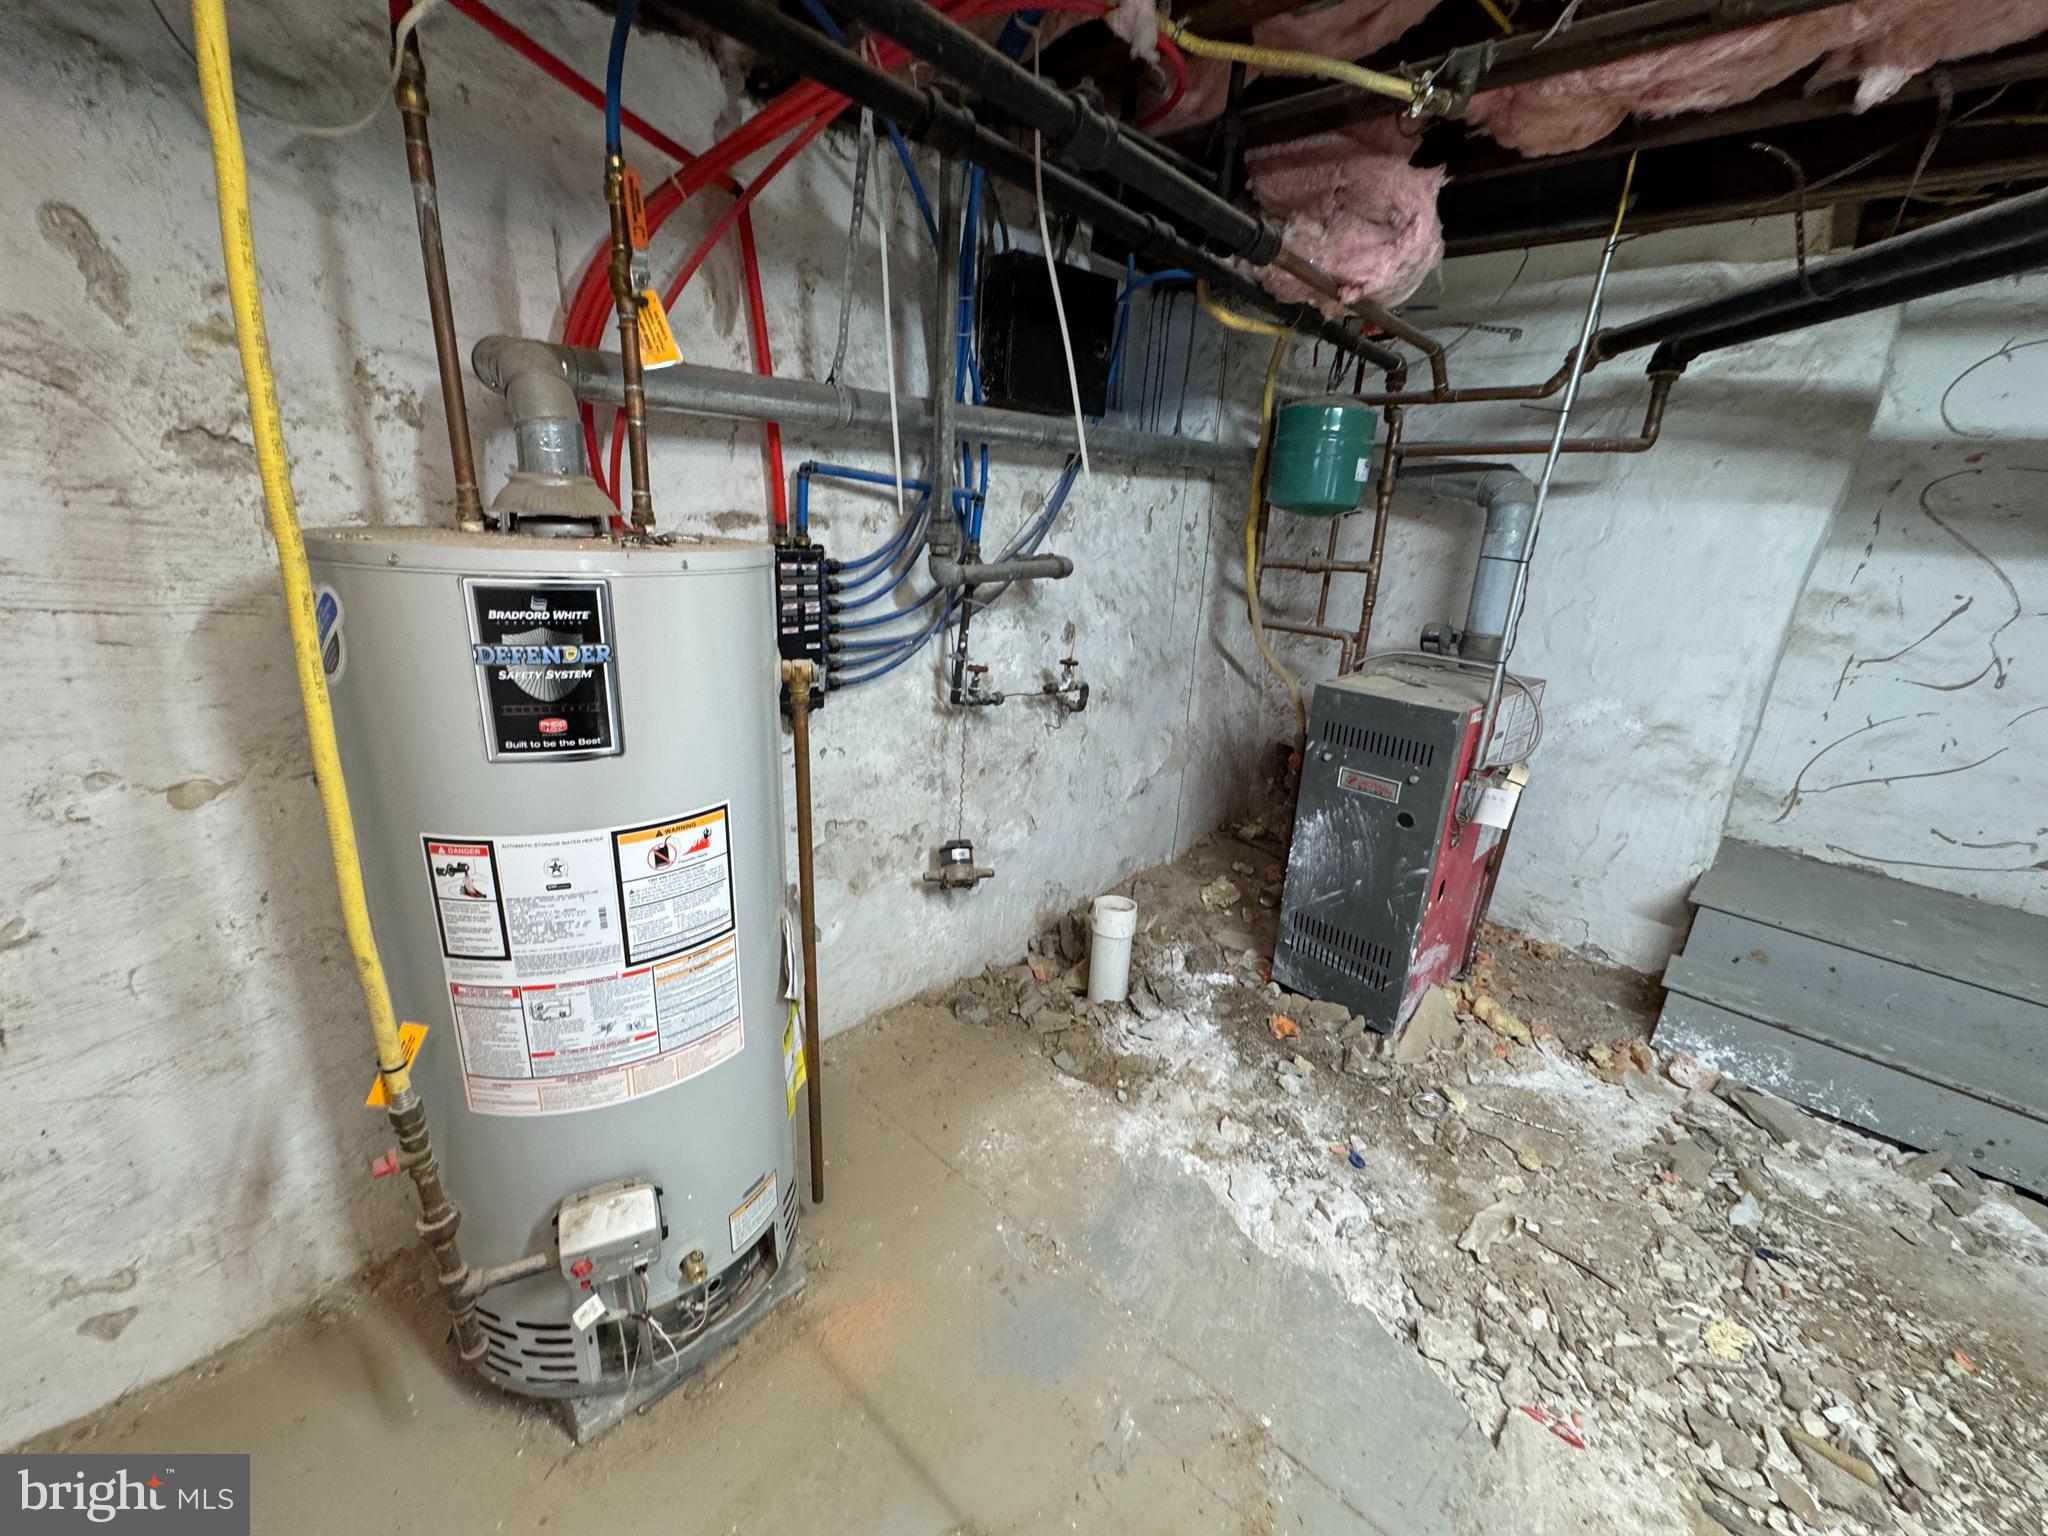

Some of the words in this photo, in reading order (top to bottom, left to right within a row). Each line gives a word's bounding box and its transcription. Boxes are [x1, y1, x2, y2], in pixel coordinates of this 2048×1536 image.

[488, 609, 550, 620] BRADFORD
[553, 609, 591, 620] WHITE
[475, 643, 612, 665] DEFENDER
[498, 670, 543, 681] SAFETY
[545, 669, 593, 681] SYSTEM
[505, 740, 528, 749] Built
[530, 740, 541, 748] to
[543, 739, 557, 748] be
[559, 738, 576, 747] the
[578, 737, 602, 746] Best
[664, 821, 697, 835] WARNING
[447, 847, 481, 856] DANGER
